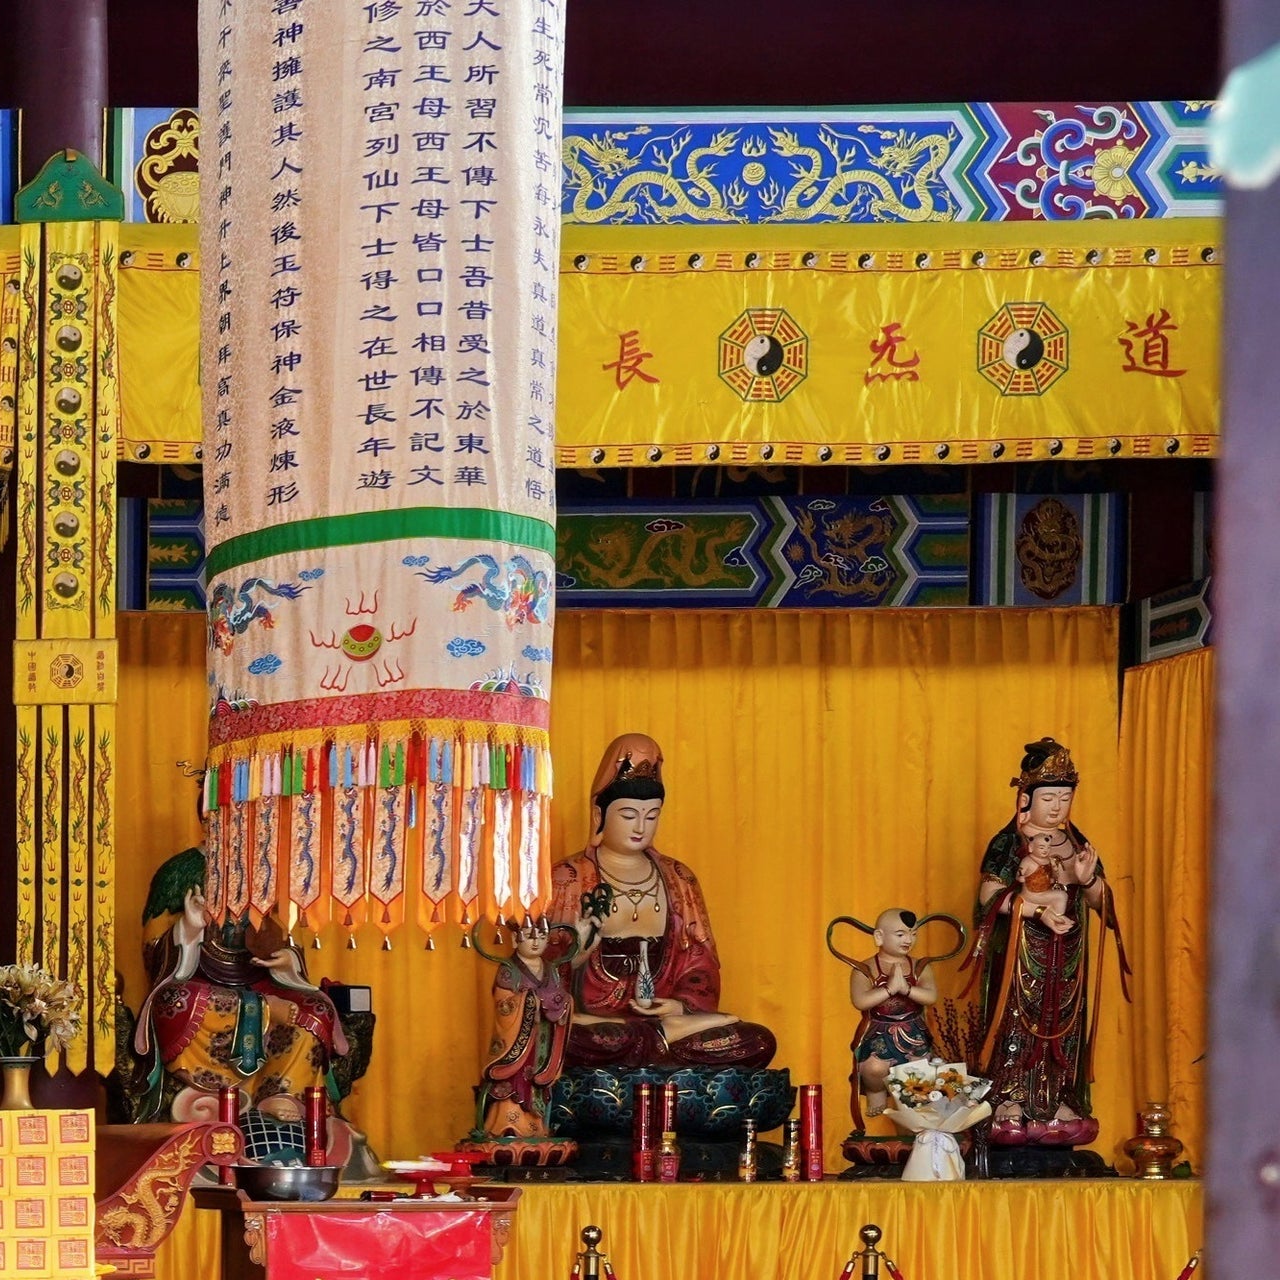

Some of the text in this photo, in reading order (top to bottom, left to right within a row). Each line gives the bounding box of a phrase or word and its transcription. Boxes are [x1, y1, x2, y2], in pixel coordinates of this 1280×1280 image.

[524, 0, 557, 501] 生死常沉苦海永失真道真常之道悟
